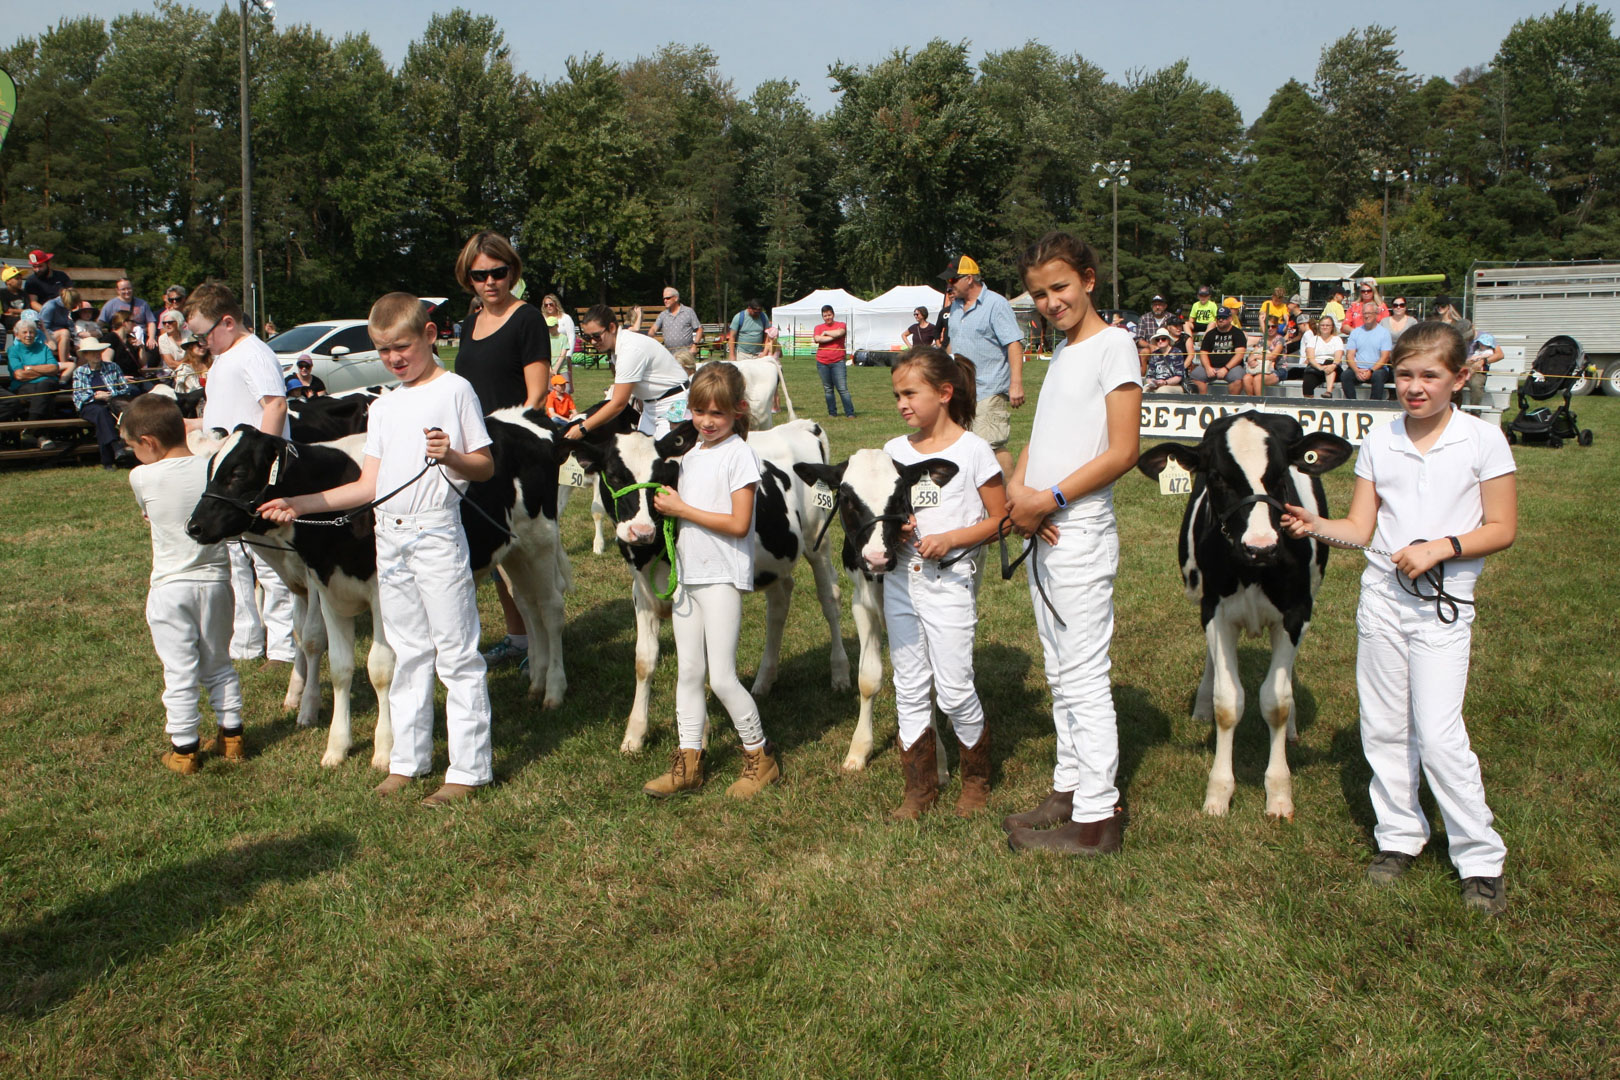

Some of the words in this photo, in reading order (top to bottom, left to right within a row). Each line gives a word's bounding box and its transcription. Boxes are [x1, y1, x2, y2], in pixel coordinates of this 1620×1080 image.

[1298, 410, 1373, 440] FAIR
[571, 472, 583, 487] 50
[1169, 477, 1191, 493] 472
[817, 493, 832, 508] 558
[919, 491, 938, 505] 558
